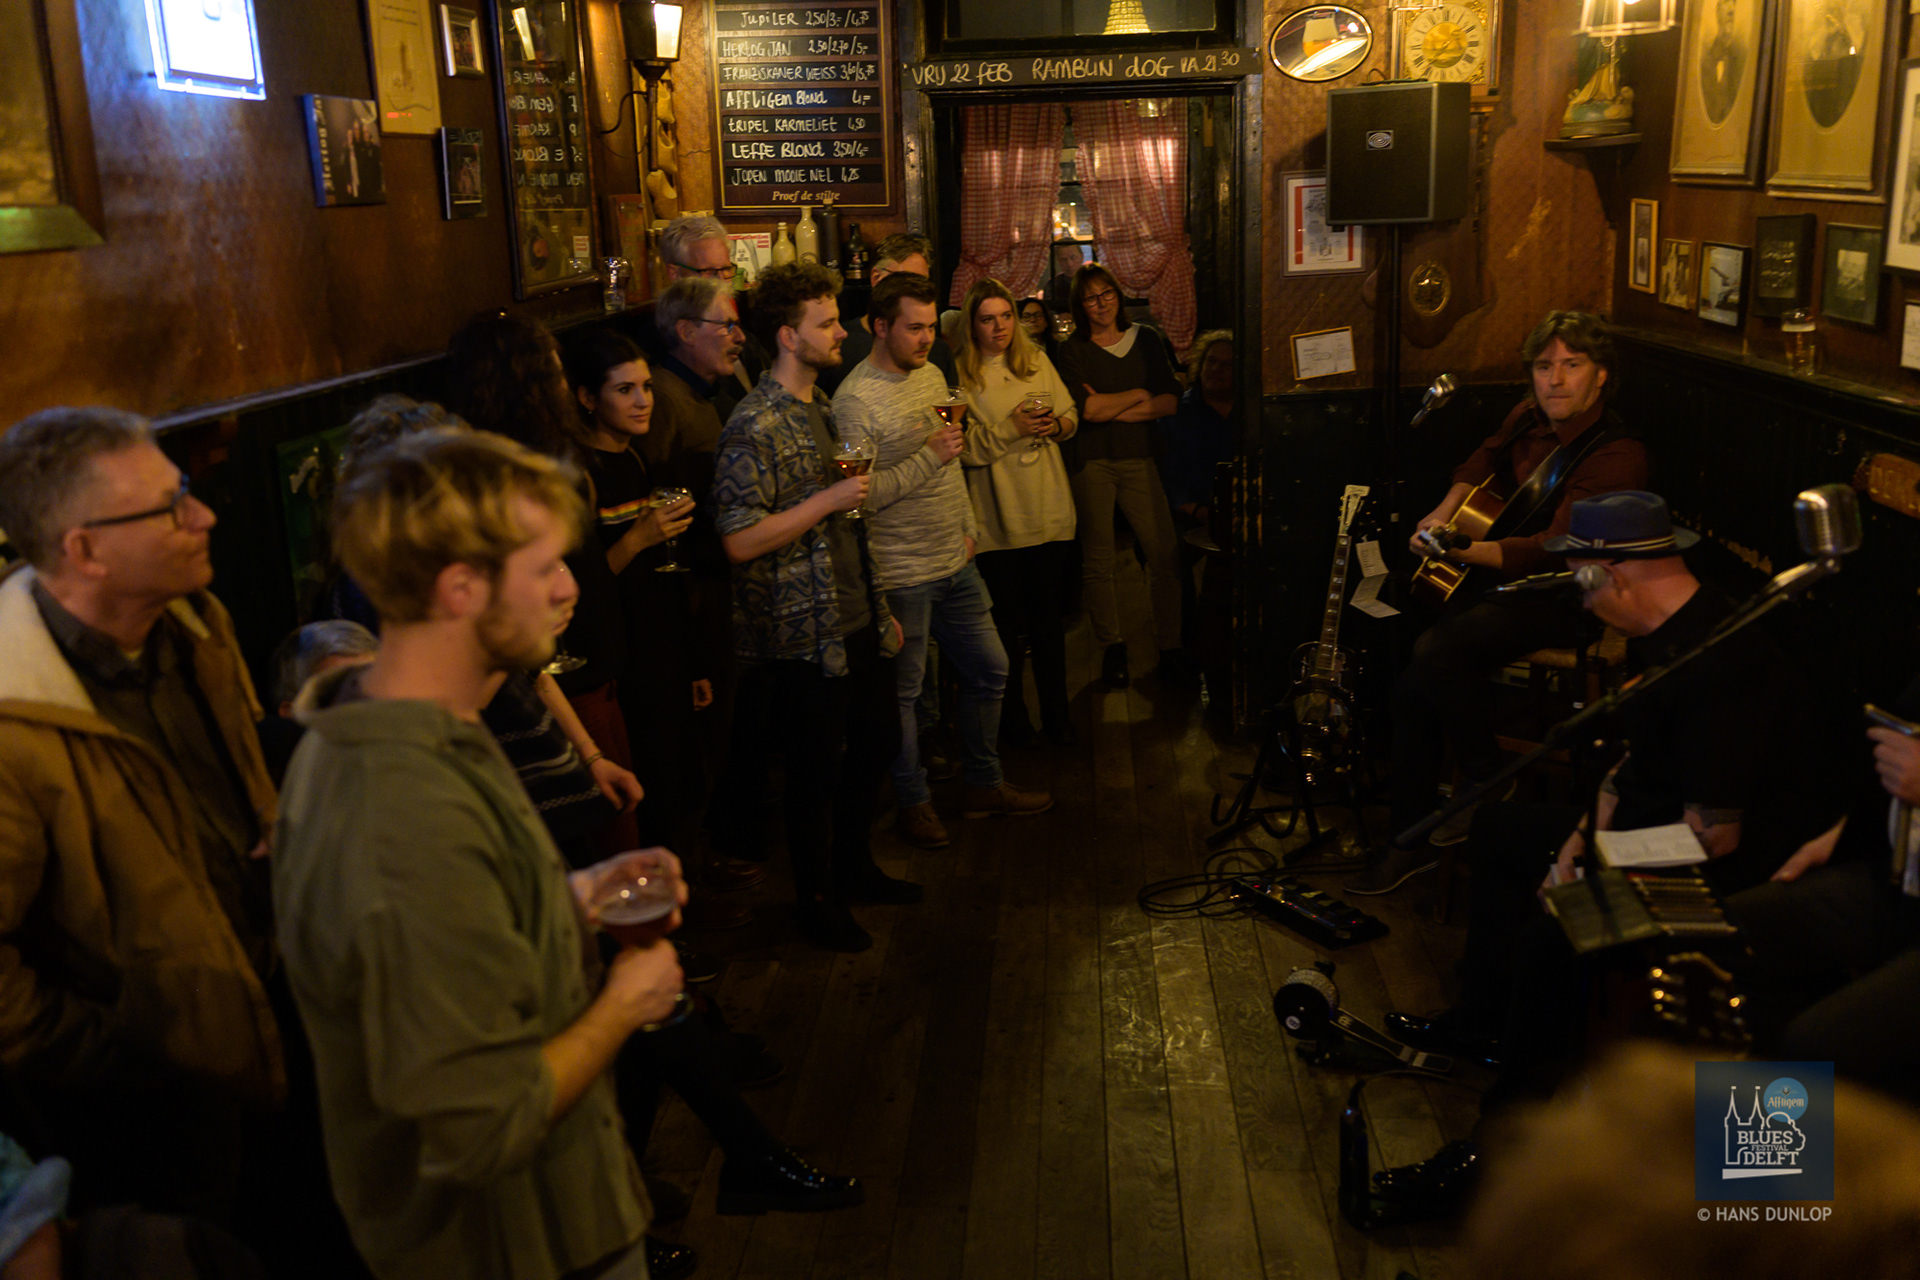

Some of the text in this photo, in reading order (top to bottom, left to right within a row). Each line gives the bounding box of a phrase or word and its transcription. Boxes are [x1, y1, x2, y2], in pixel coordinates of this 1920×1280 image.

[767, 40, 792, 57] JAN
[805, 65, 837, 81] WEISS
[950, 63, 972, 83] 22
[809, 167, 834, 183] NEL
[772, 190, 841, 203] Proef de stilte
